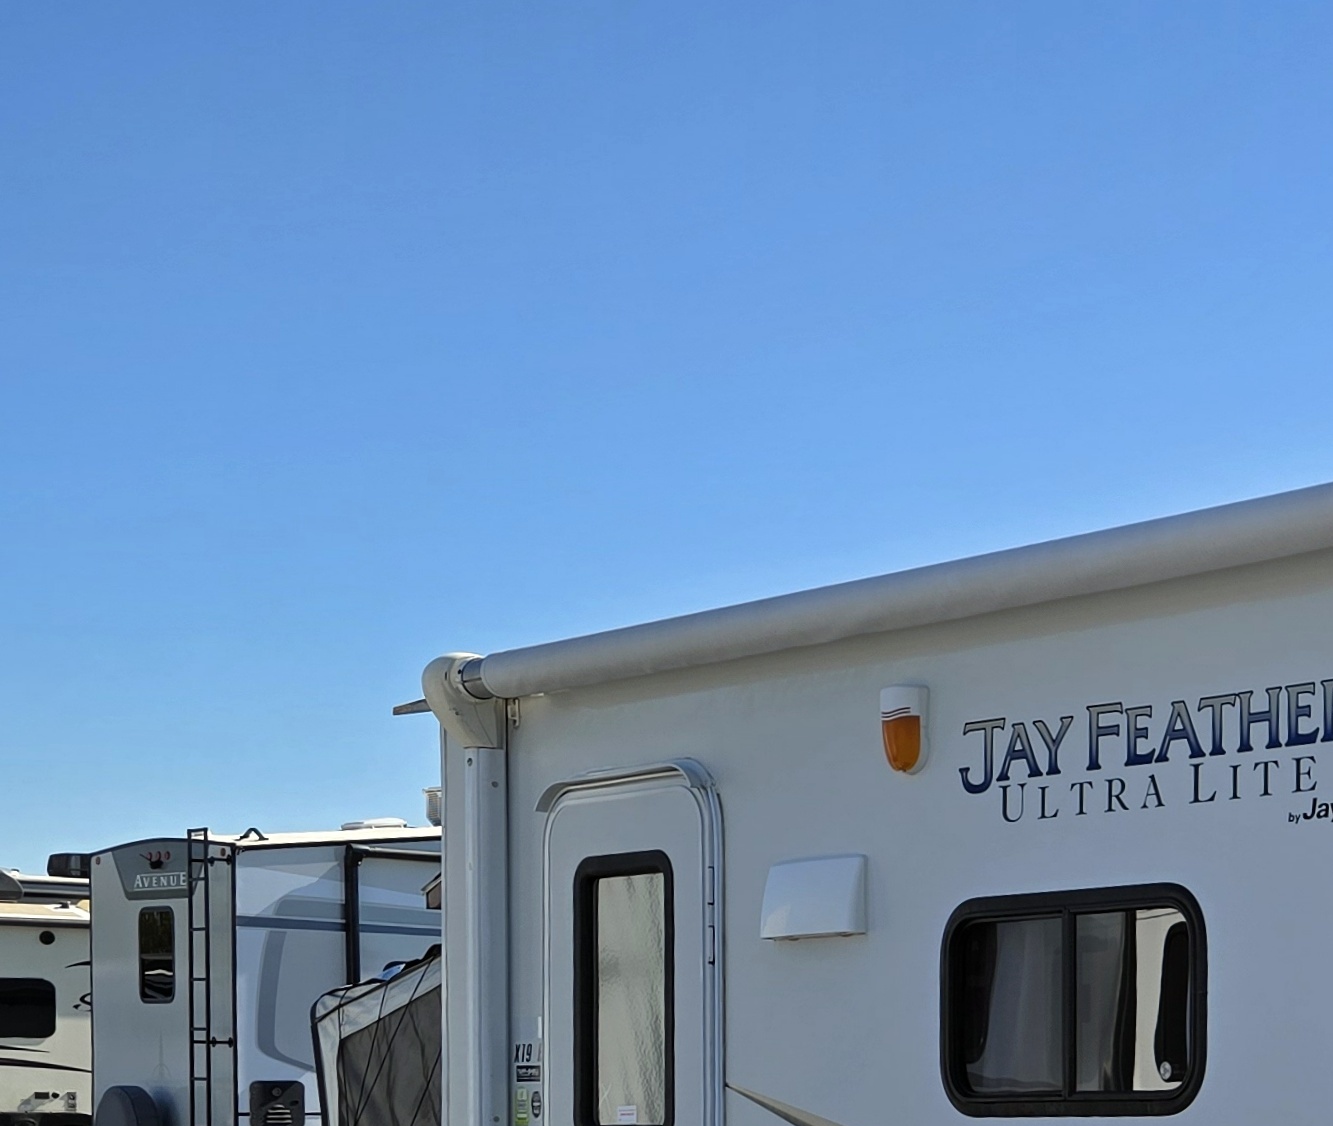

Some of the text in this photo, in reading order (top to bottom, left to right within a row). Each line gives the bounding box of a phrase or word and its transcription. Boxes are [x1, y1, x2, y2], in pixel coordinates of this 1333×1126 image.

[959, 715, 1074, 794] JAY
[1000, 756, 1318, 822] ULTRA LITE
[1288, 812, 1300, 824] by
[134, 872, 186, 888] AVENUE
